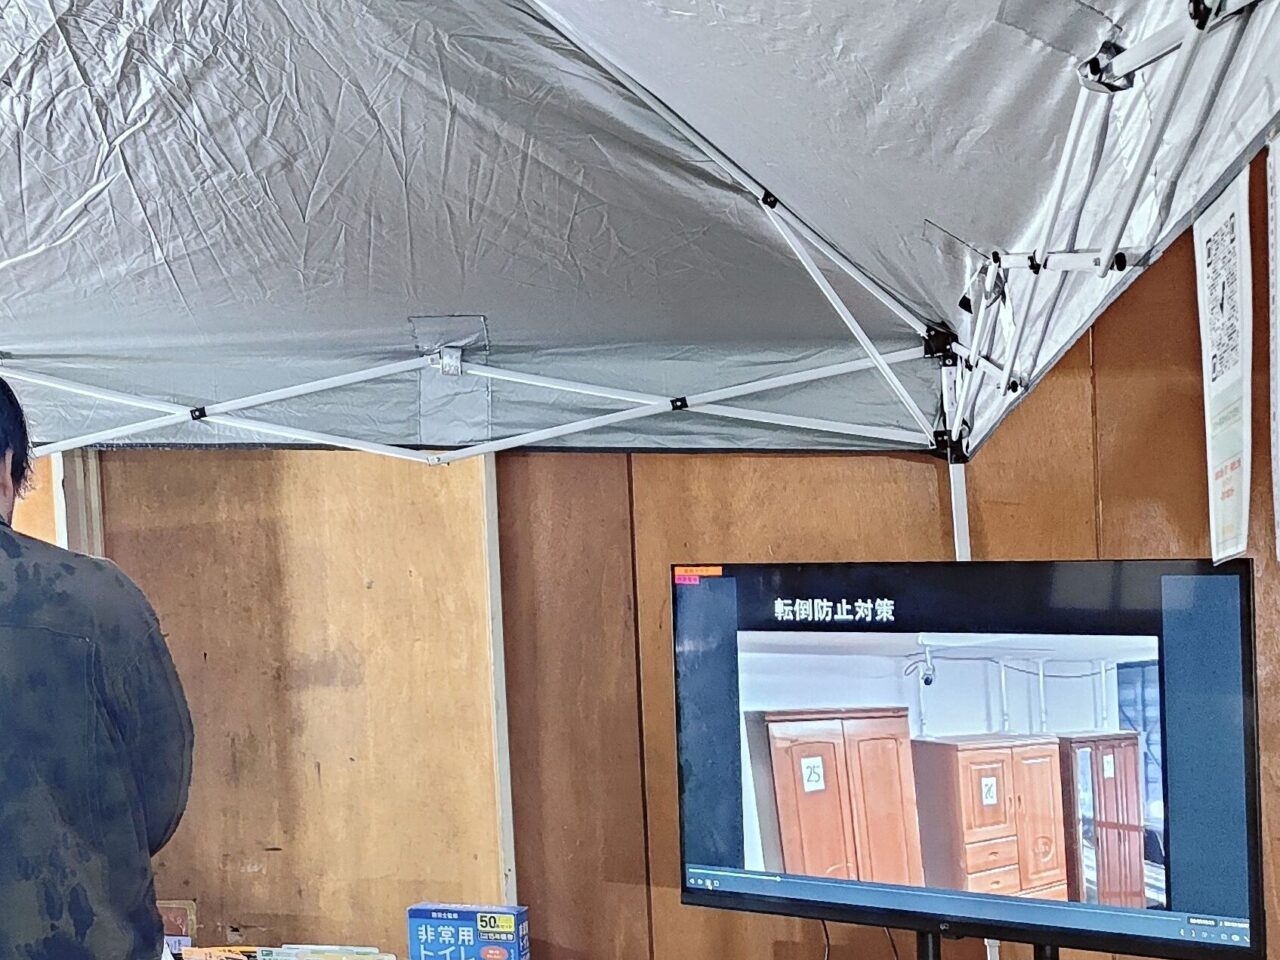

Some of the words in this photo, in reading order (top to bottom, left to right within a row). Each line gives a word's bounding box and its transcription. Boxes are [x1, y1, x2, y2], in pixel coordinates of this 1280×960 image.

[774, 598, 895, 622] 転倒防止対策
[806, 765, 820, 783] 25
[479, 915, 497, 929] 50
[417, 924, 475, 946] 非常用
